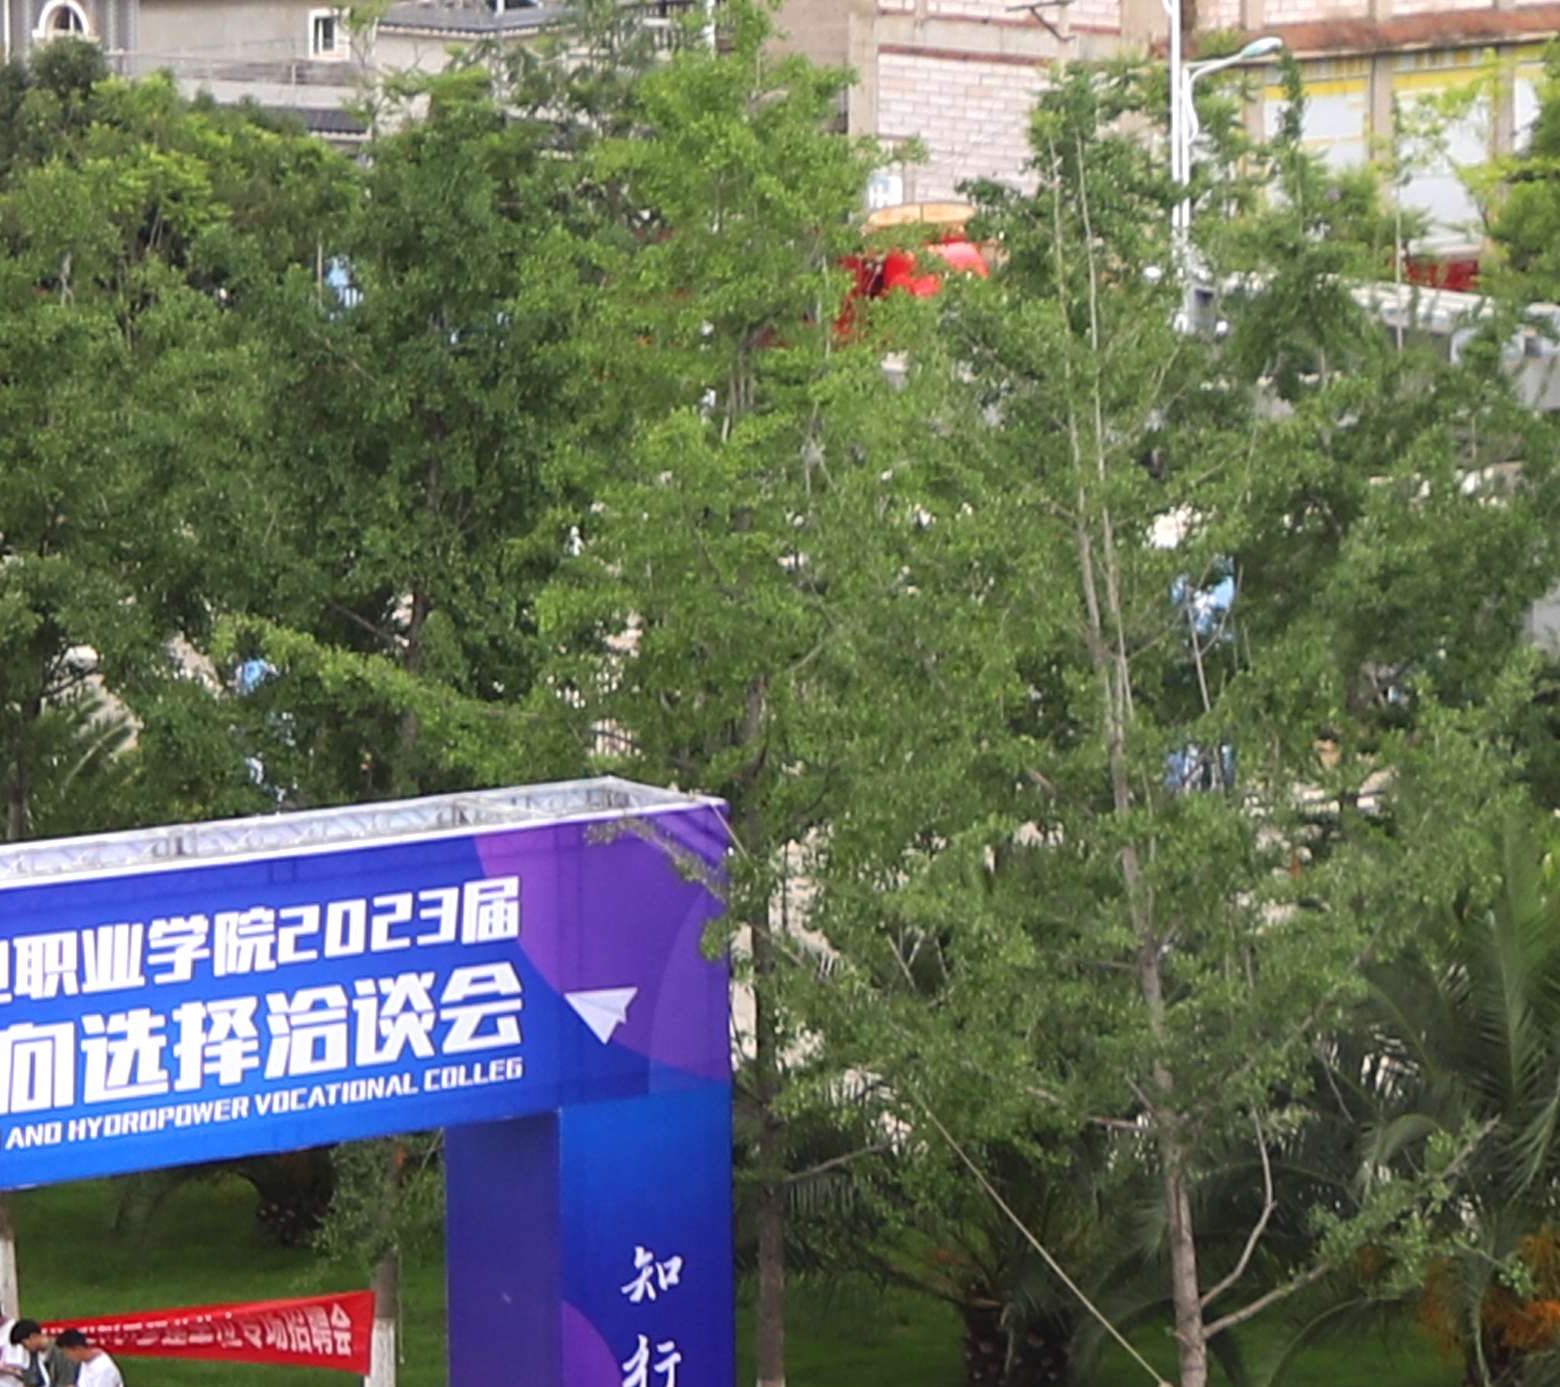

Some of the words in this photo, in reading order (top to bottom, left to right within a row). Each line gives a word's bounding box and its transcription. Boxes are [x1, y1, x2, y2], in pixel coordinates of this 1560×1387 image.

[6, 1122, 62, 1149] AND
[68, 1098, 249, 1141] HYDROPOWER
[255, 1071, 418, 1116] VOCATIONAL
[425, 1057, 522, 1091] COLLEG
